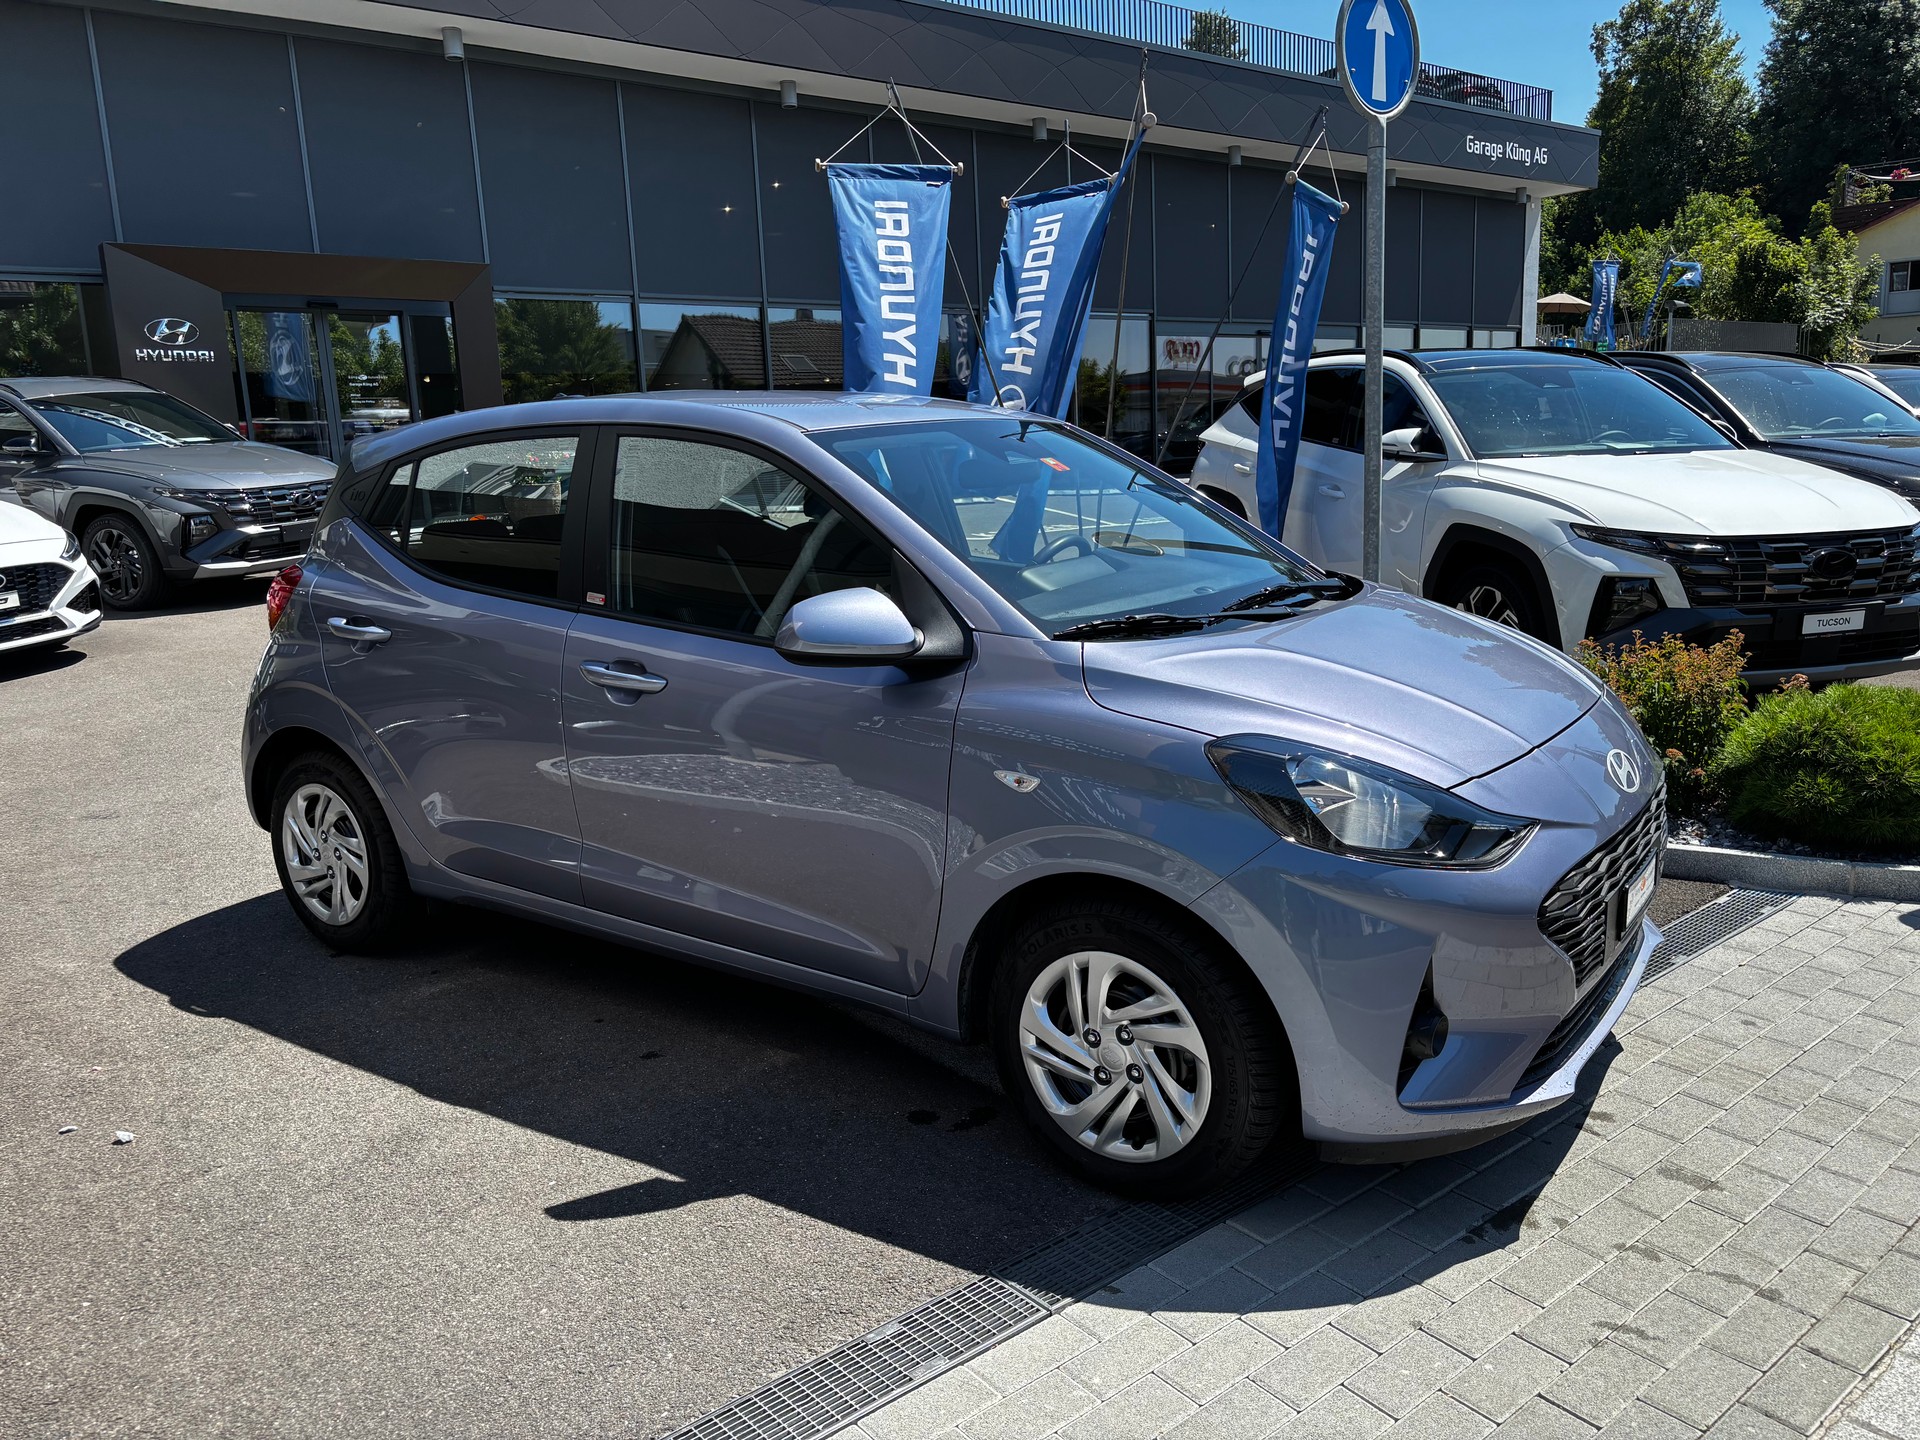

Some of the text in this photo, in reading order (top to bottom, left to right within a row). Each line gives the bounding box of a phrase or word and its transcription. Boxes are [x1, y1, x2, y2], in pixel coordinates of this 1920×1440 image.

[1466, 135, 1548, 167] Garage Küng AG
[135, 348, 215, 362] HYUNDAI
[350, 488, 366, 501] i10
[1817, 617, 1851, 627] TUCSON
[1020, 923, 1079, 963] POLARIS
